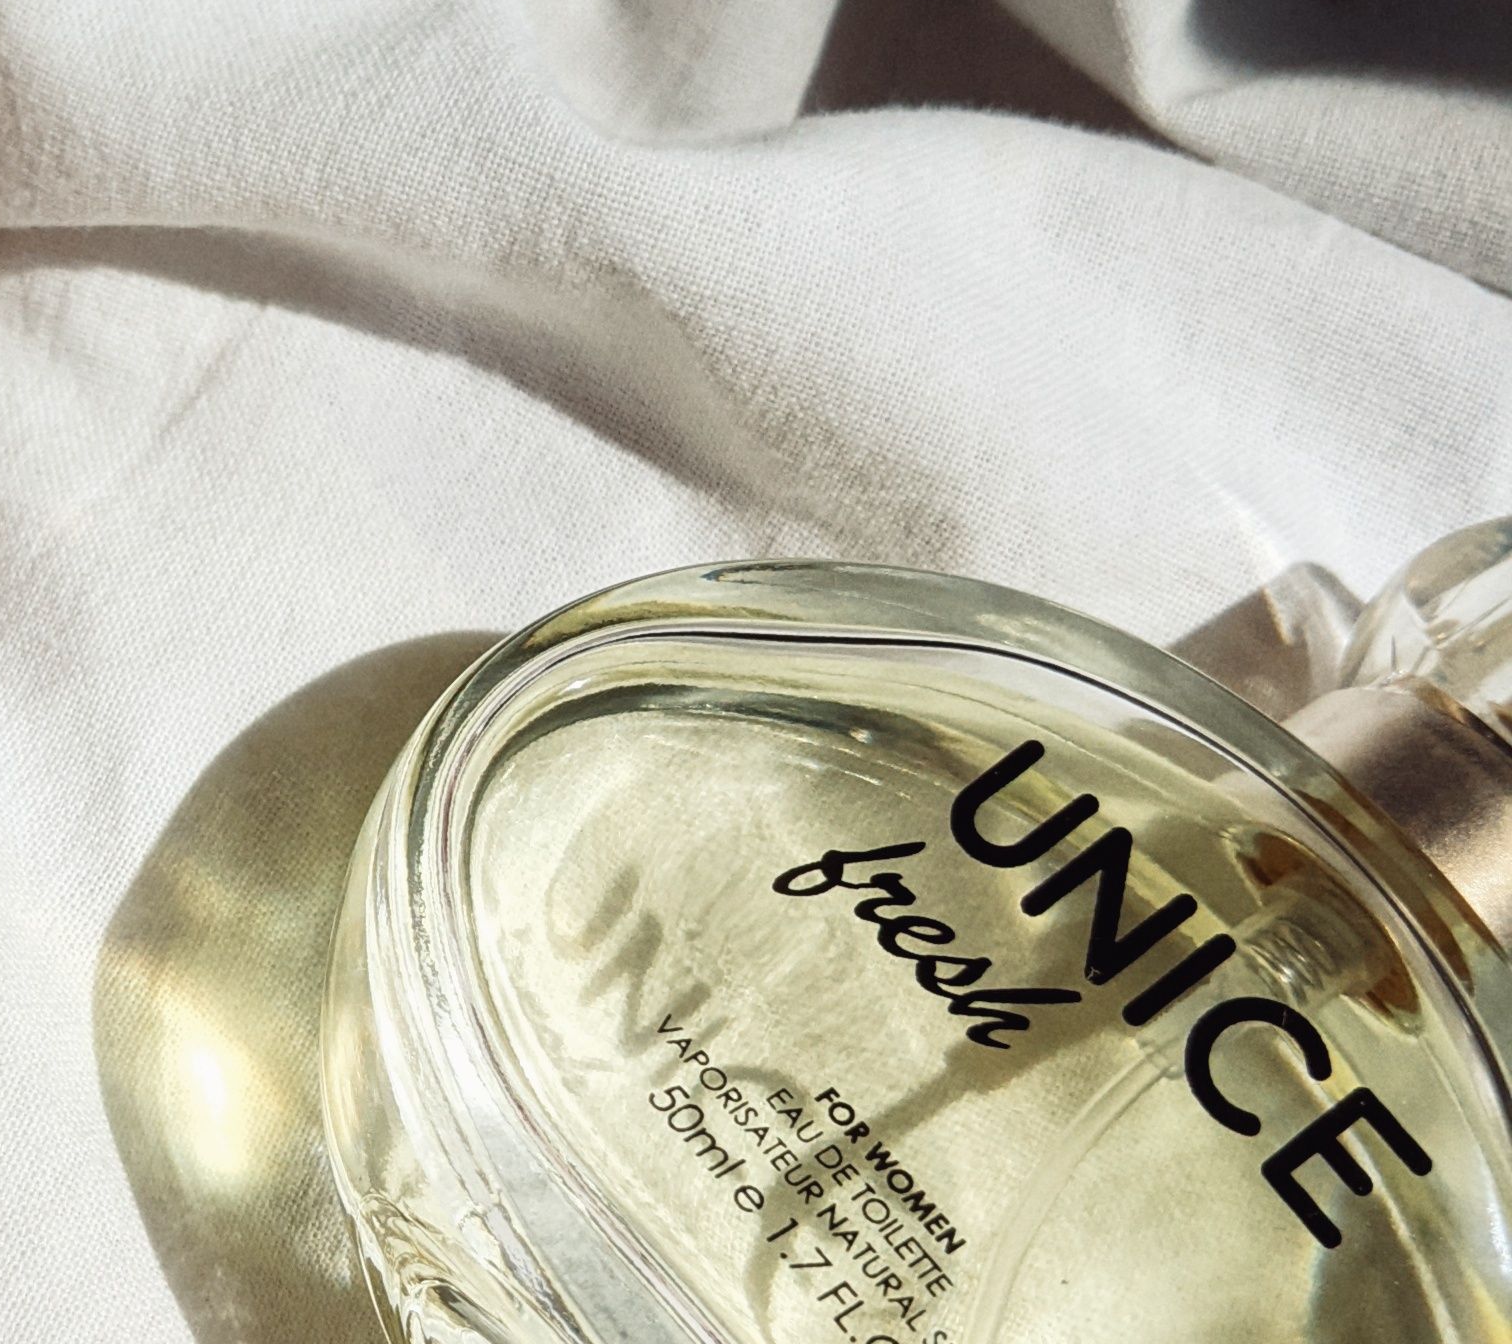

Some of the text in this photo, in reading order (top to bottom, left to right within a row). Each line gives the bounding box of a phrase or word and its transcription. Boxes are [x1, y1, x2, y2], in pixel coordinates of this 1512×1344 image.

[772, 841, 1083, 1050] fresh
[951, 740, 1433, 1249] UNICE
[648, 1085, 746, 1179] 50ml
[766, 1217, 833, 1272] 1.7
[656, 1012, 825, 1205] VAPORISATEUR
[816, 1203, 927, 1333] NATURAL
[766, 1087, 954, 1298] EAU DE TOILETTE
[815, 1086, 967, 1255] FOR WOMEN
